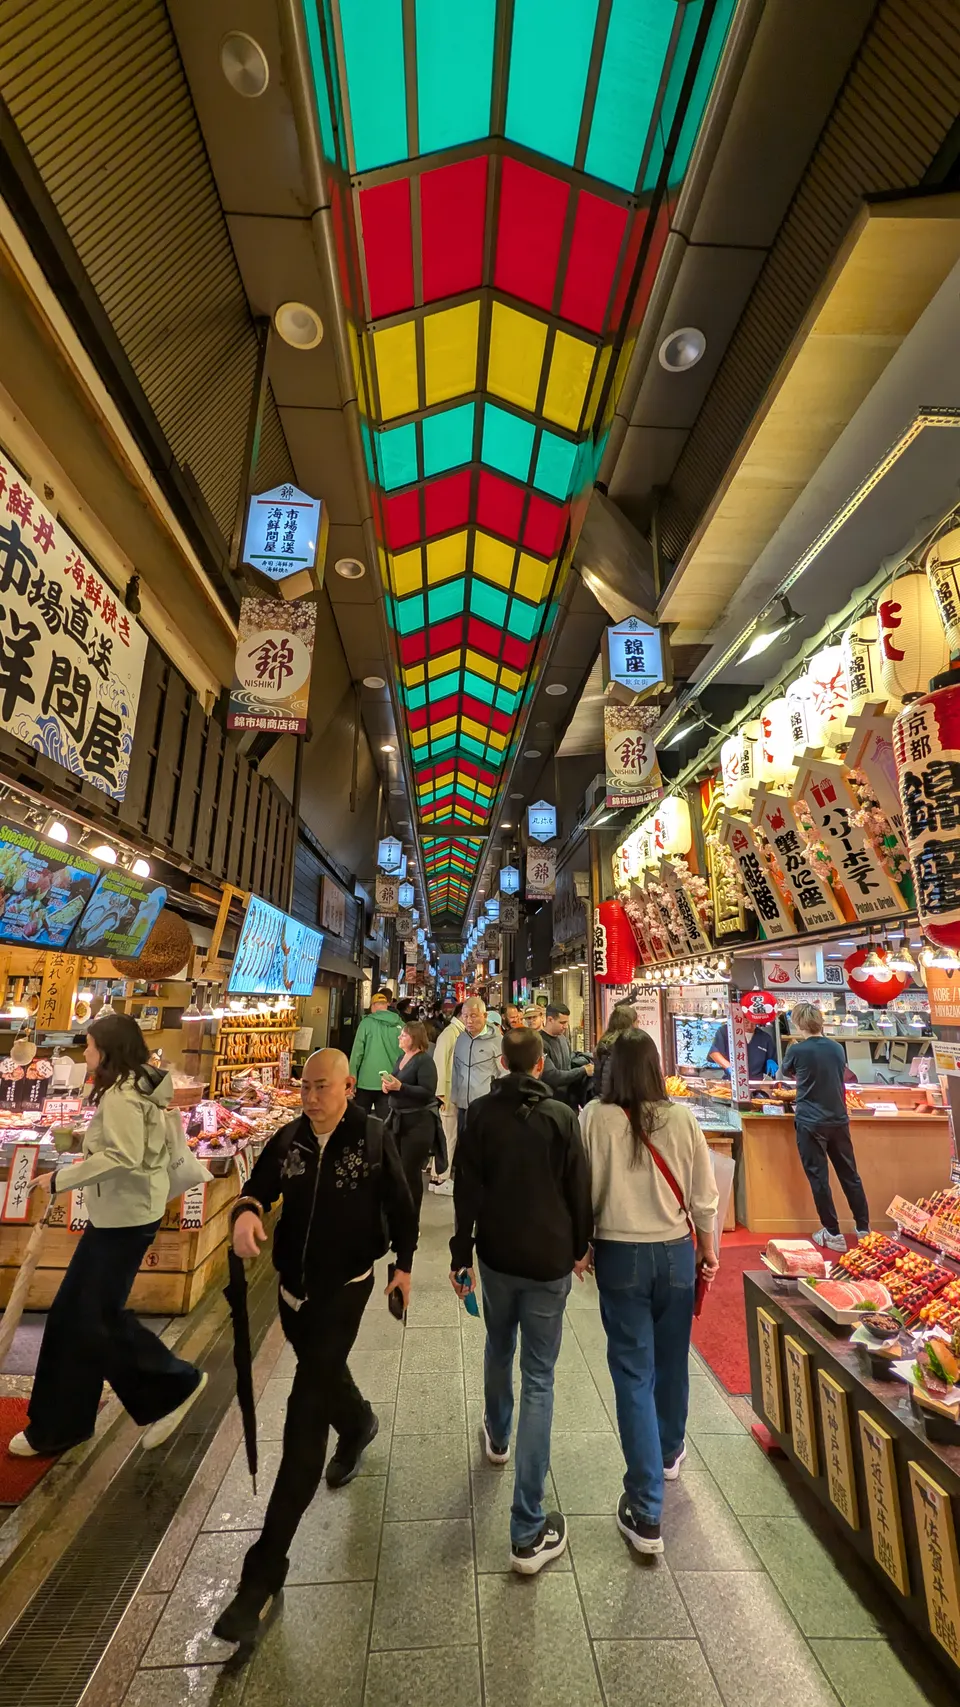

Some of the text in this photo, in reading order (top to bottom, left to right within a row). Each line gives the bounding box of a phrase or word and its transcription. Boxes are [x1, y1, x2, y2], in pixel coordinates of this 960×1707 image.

[0, 463, 56, 554] 鮮丼
[264, 508, 283, 552] 海鮮問屋
[281, 508, 299, 554] 市場直送
[64, 549, 130, 647] 海鮮焼き
[248, 639, 294, 691] 錦
[624, 639, 646, 672] 錦座
[244, 678, 275, 690] NISHIKI
[234, 716, 299, 731] 錦市場商店街
[906, 712, 931, 763] 京都
[614, 737, 647, 776] 錦
[612, 791, 659, 806] 錦市場商店街
[37, 840, 69, 864] Tempura
[67, 855, 75, 865] &
[531, 863, 549, 884] 錦
[380, 887, 394, 904] 錦
[855, 900, 873, 915] Potato
[879, 896, 896, 909] Drink
[40, 953, 64, 1027] 溢れる肉汁
[932, 988, 950, 1002] KOBE
[827, 1410, 842, 1477] 神戸牛
[870, 1457, 890, 1534] 近江牛
[878, 1531, 894, 1558] OMI
[879, 1548, 897, 1579] BEEF
[924, 1513, 949, 1605] 佐賀牛
[932, 1597, 957, 1642] SAGA
[935, 1620, 959, 1658] BEEF
